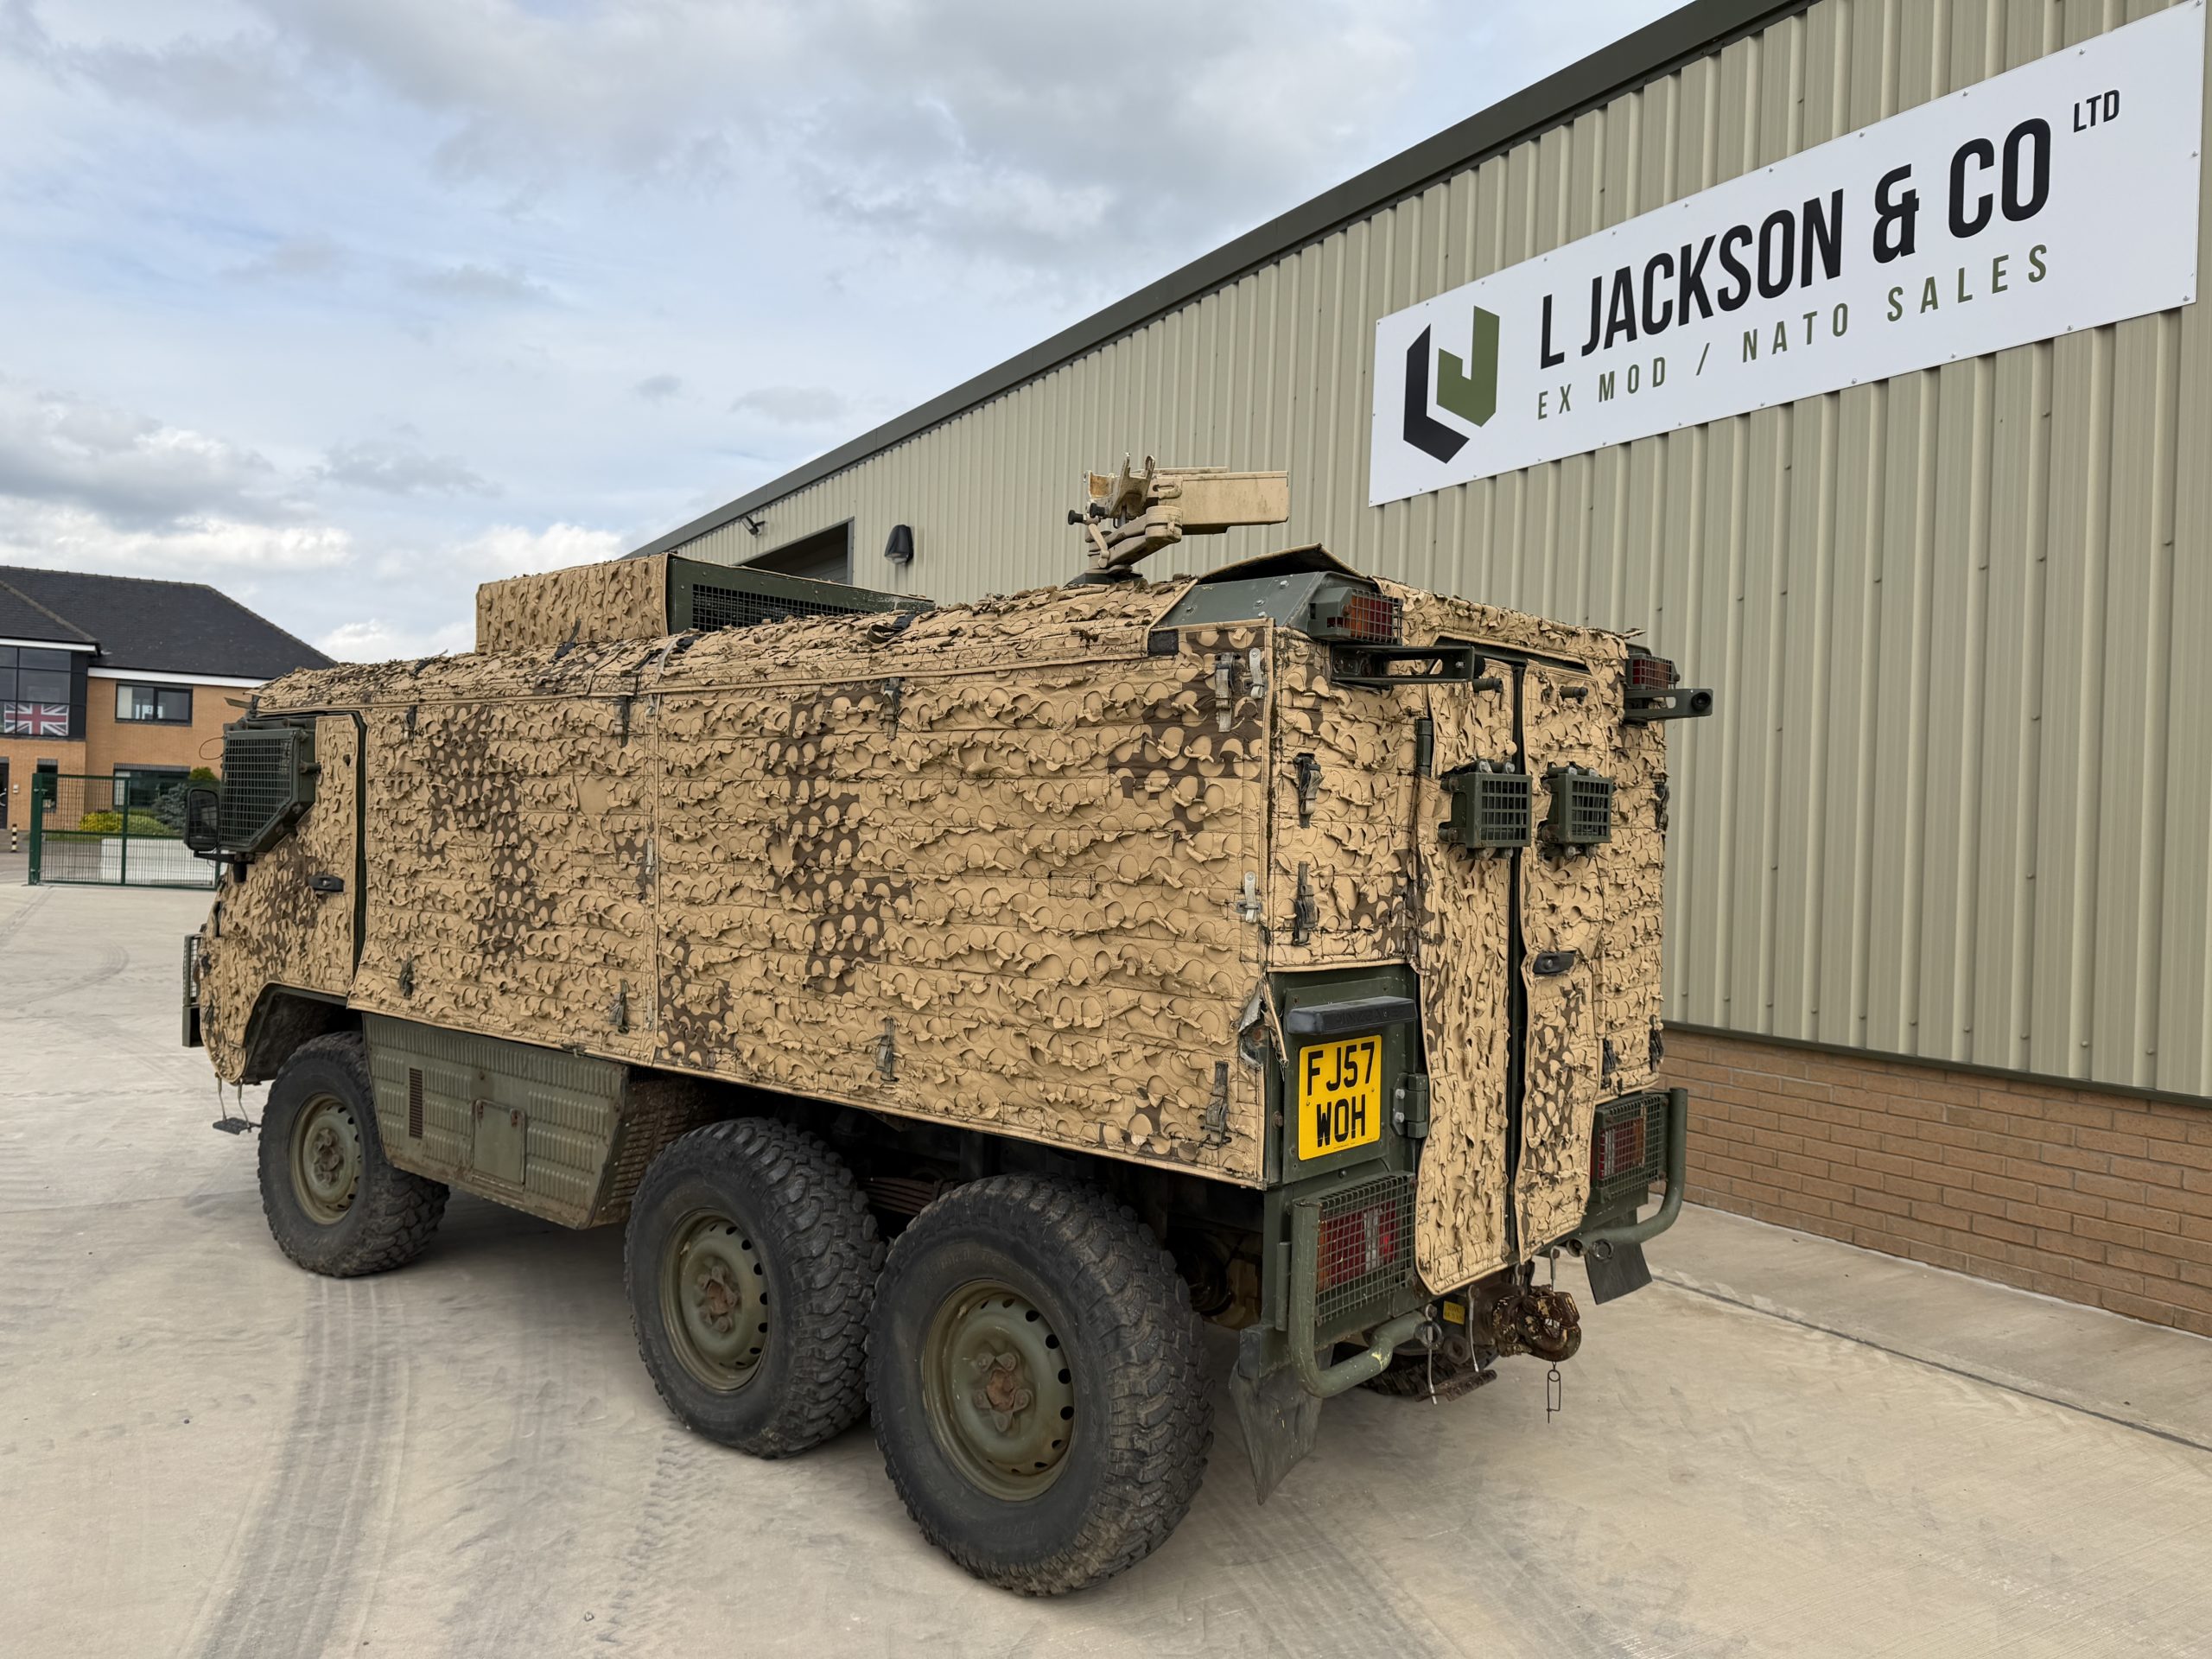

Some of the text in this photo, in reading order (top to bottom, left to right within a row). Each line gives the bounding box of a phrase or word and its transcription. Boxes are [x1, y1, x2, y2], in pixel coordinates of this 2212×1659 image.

[1540, 90, 2120, 370] L JACKSON & CO LTD
[1537, 383, 1572, 420] EX
[1599, 356, 1666, 403] MOD
[1742, 302, 1848, 363] NATO
[1887, 244, 2047, 322] SALES
[1307, 1041, 1376, 1096] FJ57
[1316, 1094, 1366, 1148] WOH
